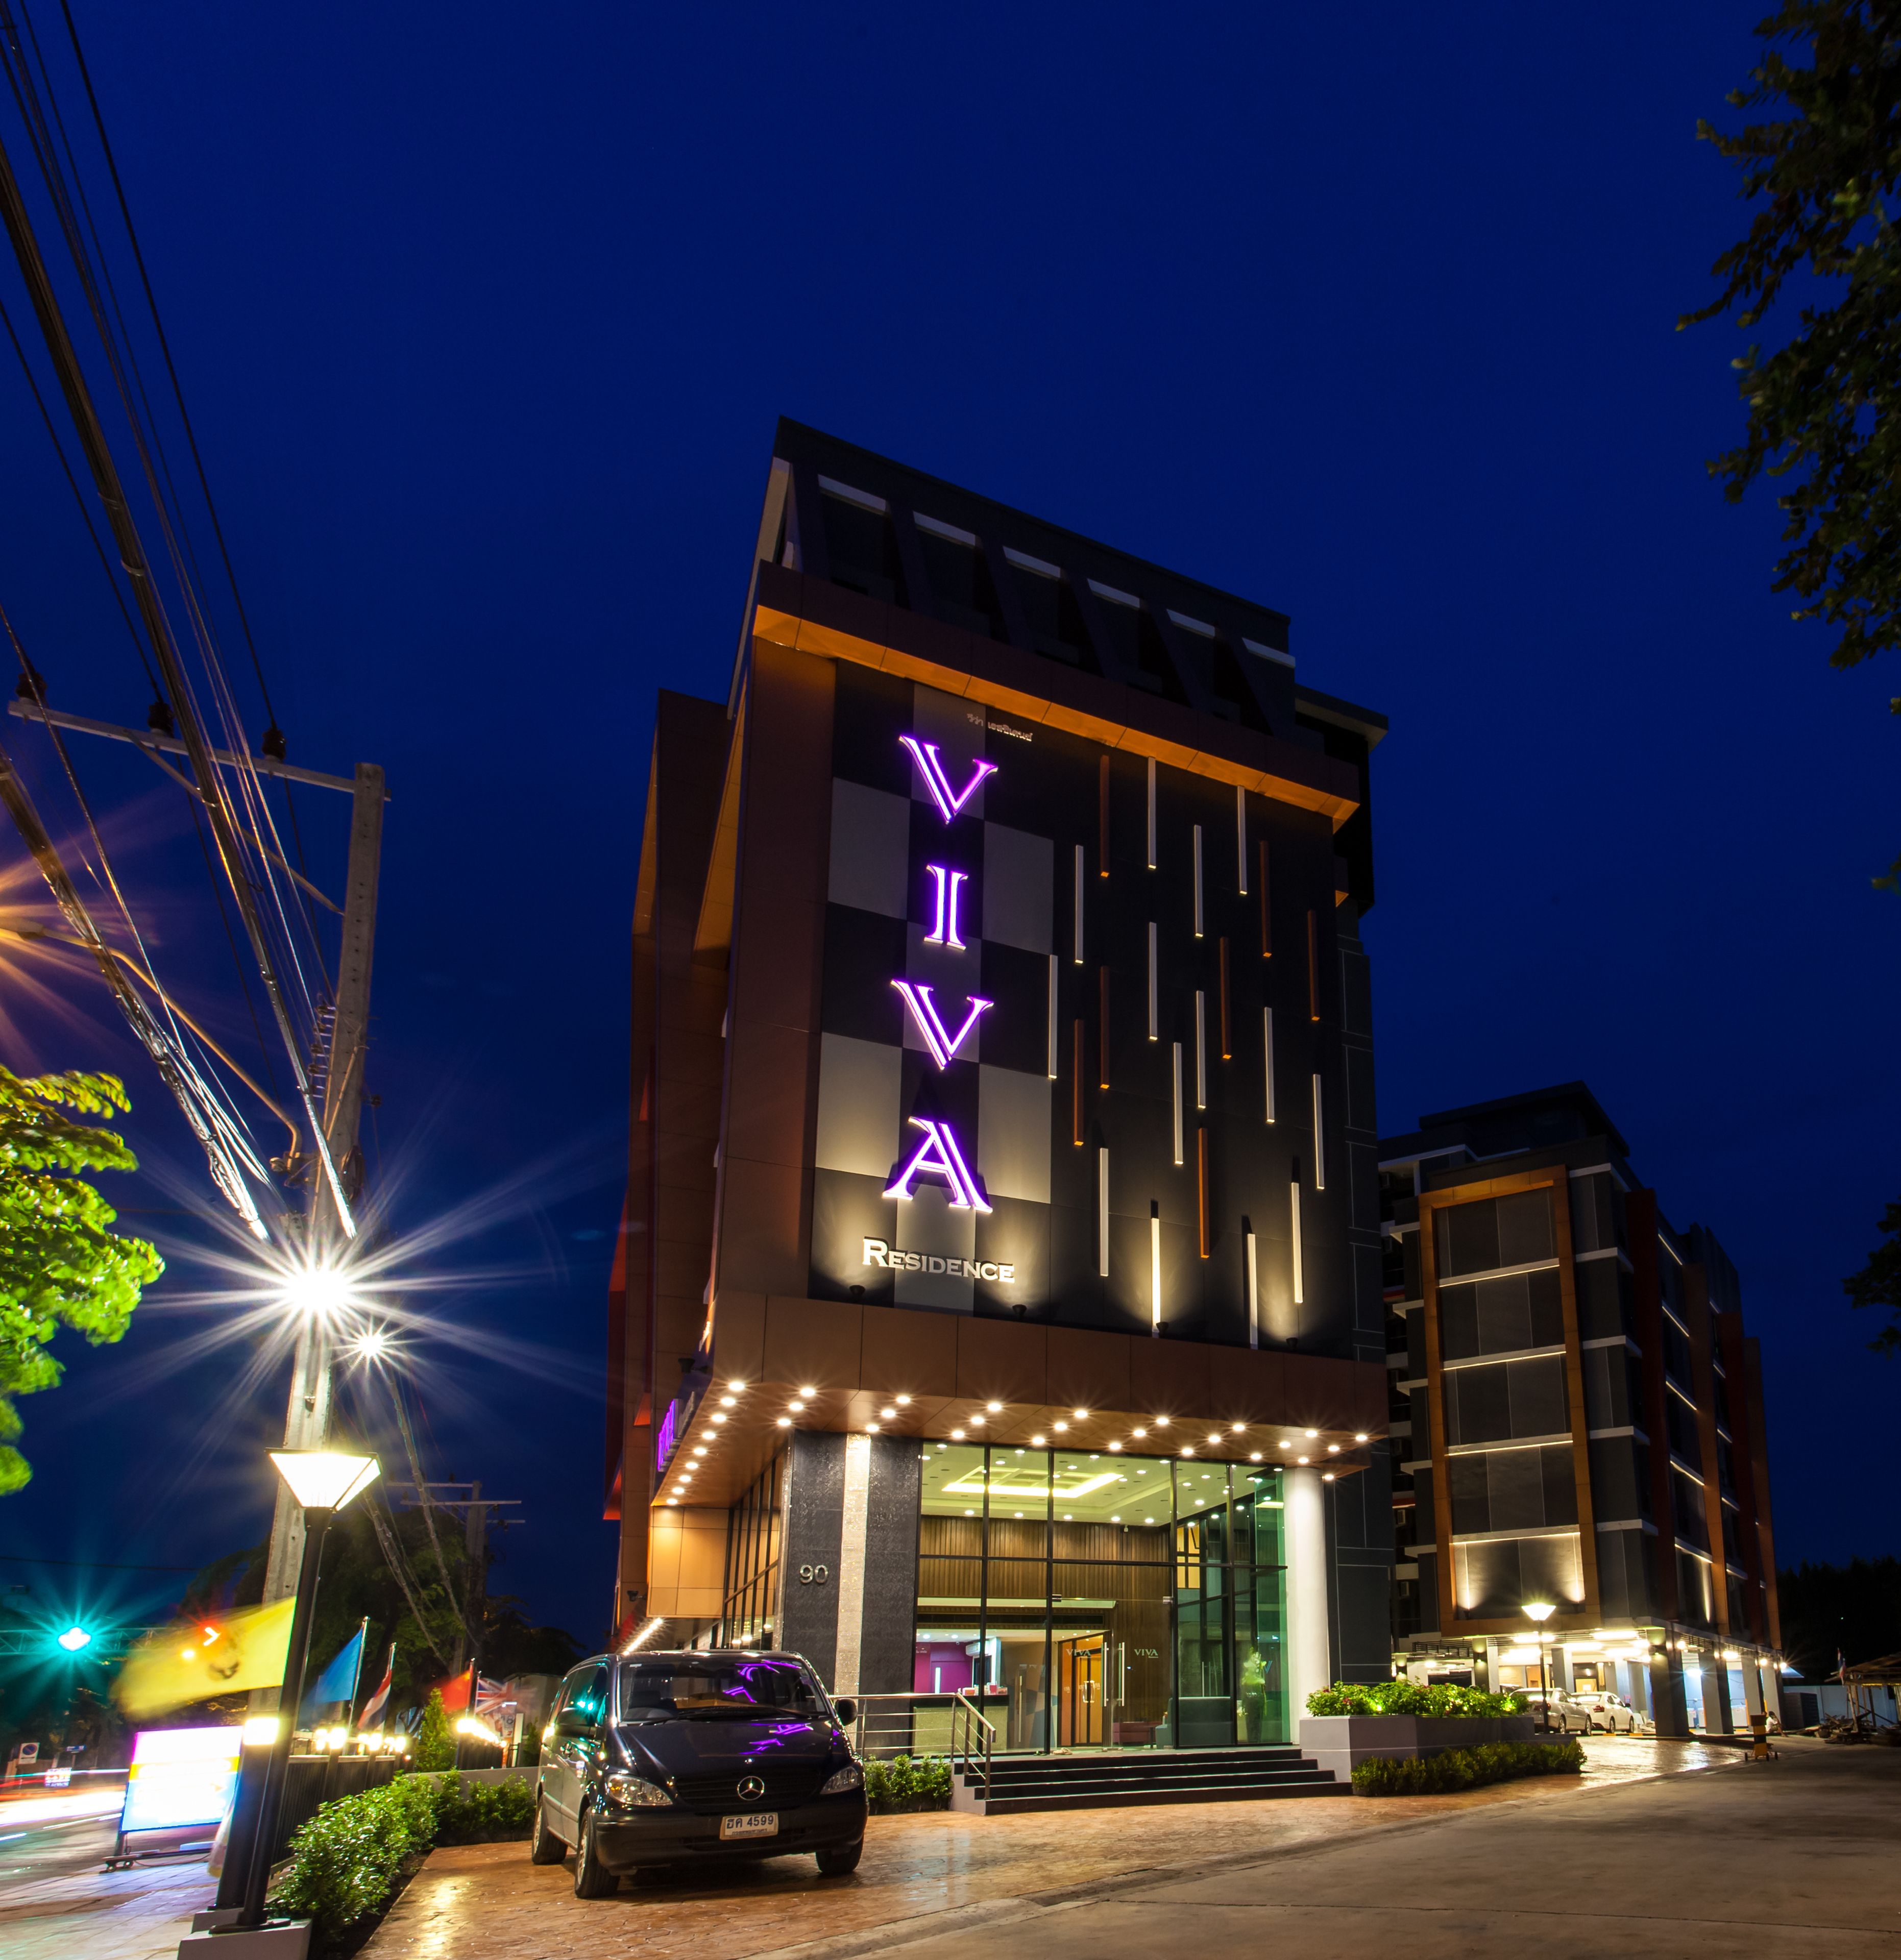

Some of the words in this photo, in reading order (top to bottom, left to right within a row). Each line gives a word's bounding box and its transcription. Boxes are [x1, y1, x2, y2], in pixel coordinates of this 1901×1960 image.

[882, 735, 998, 1214] VIVA
[862, 1238, 1015, 1283] RESIDENCE
[799, 1564, 828, 1584] 90
[747, 1815, 774, 1826] 4599
